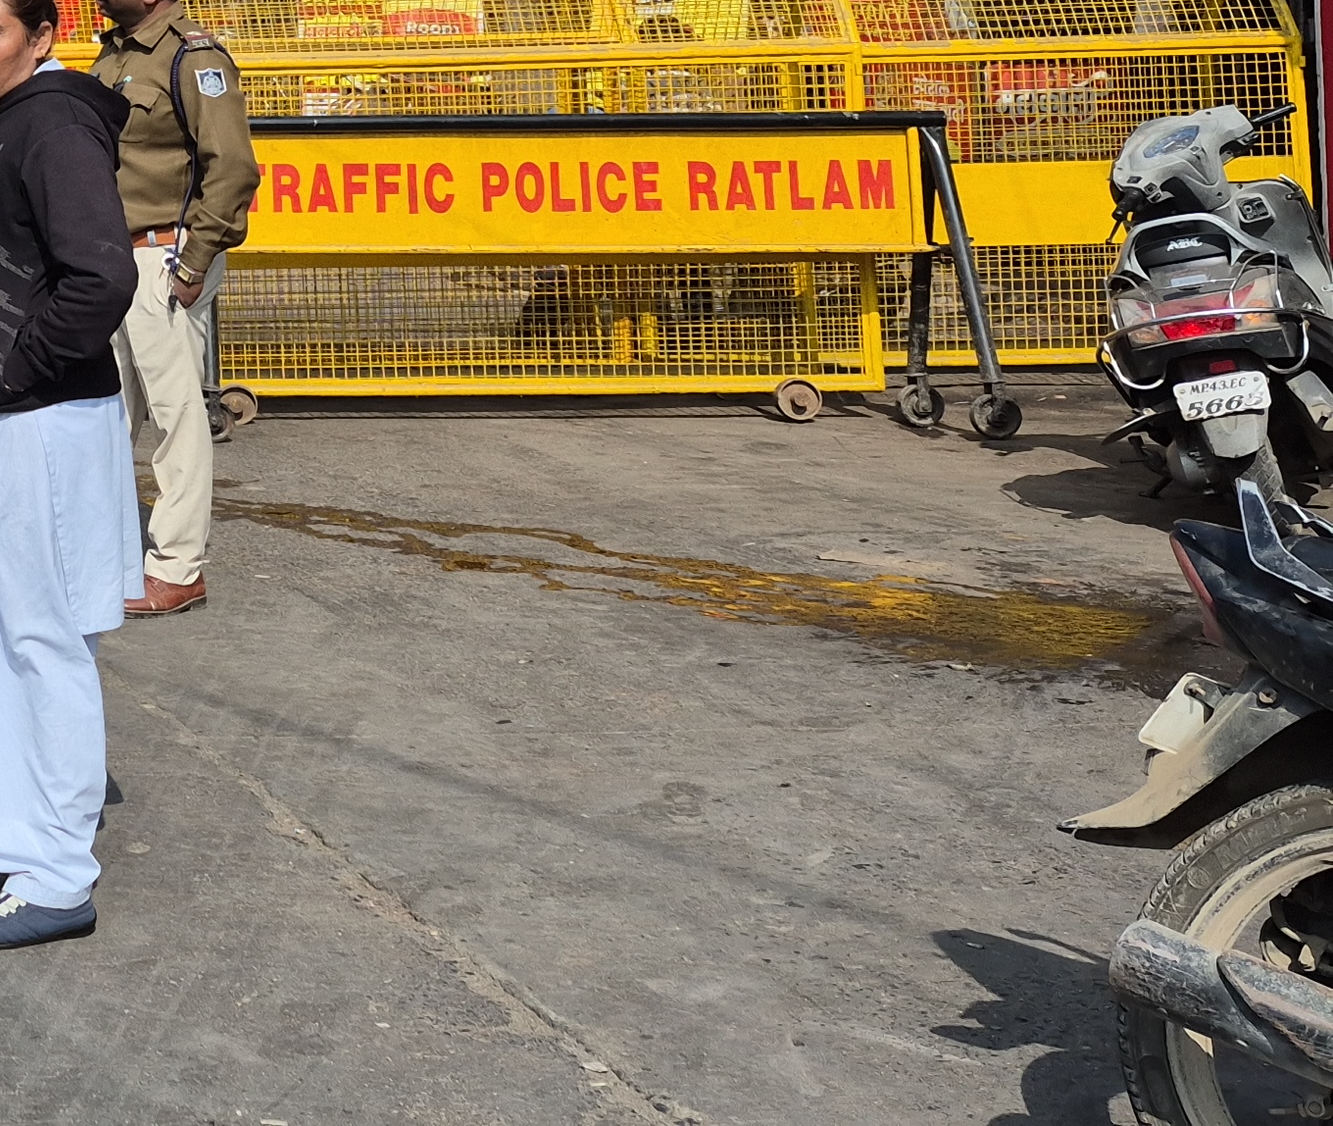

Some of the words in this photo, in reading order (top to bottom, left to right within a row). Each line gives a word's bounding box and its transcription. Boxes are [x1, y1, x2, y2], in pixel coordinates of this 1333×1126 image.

[249, 162, 456, 216] TRAFFIC
[481, 160, 663, 215] POLICE
[687, 158, 897, 213] RATLAM
